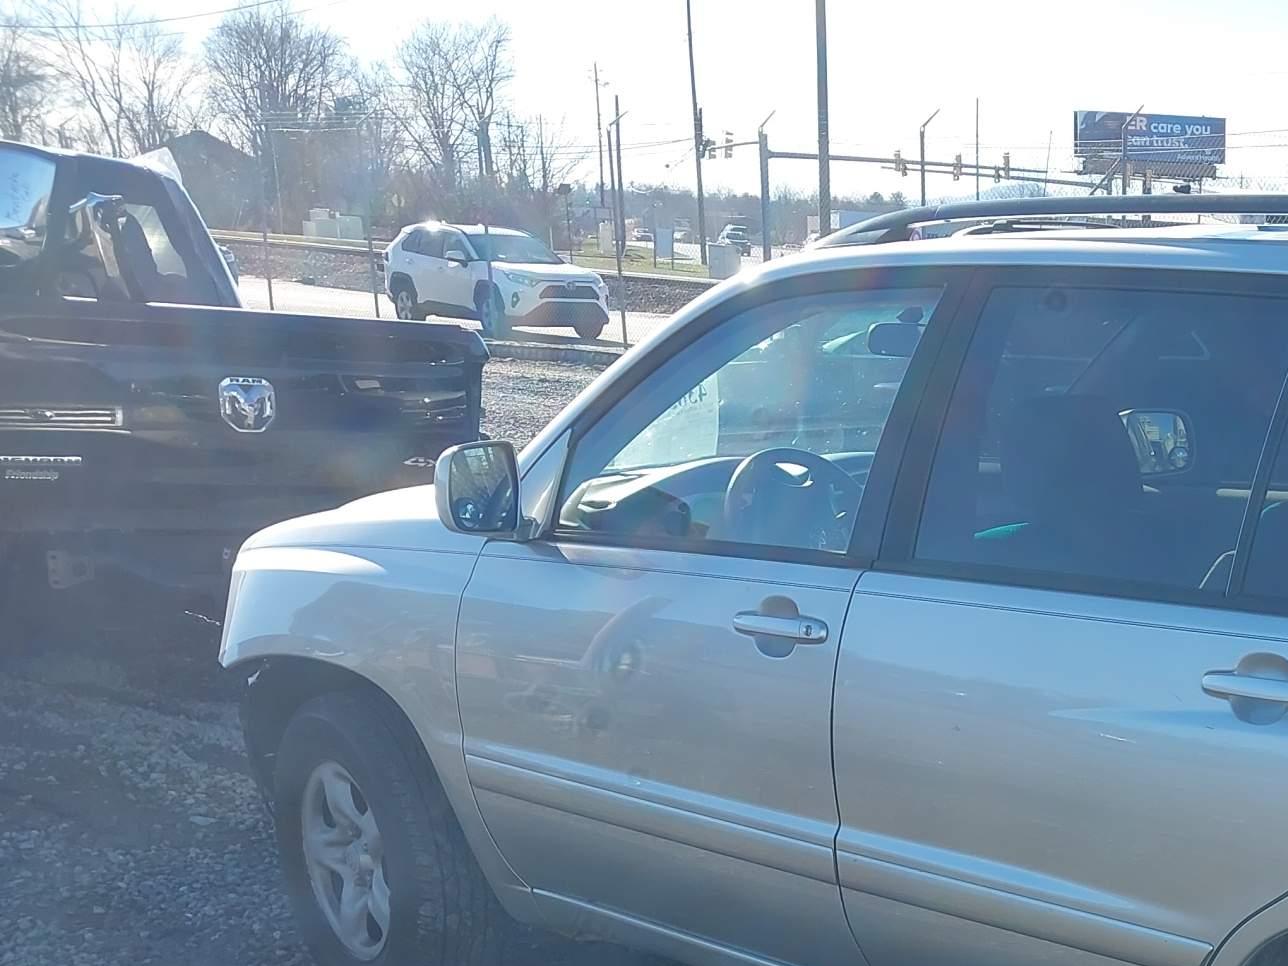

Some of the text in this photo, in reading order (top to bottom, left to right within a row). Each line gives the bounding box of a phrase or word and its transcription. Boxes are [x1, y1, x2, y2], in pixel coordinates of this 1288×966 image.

[1150, 123, 1181, 134] care
[1184, 124, 1211, 137] you
[1152, 135, 1189, 149] trust.
[229, 377, 263, 385] RAM
